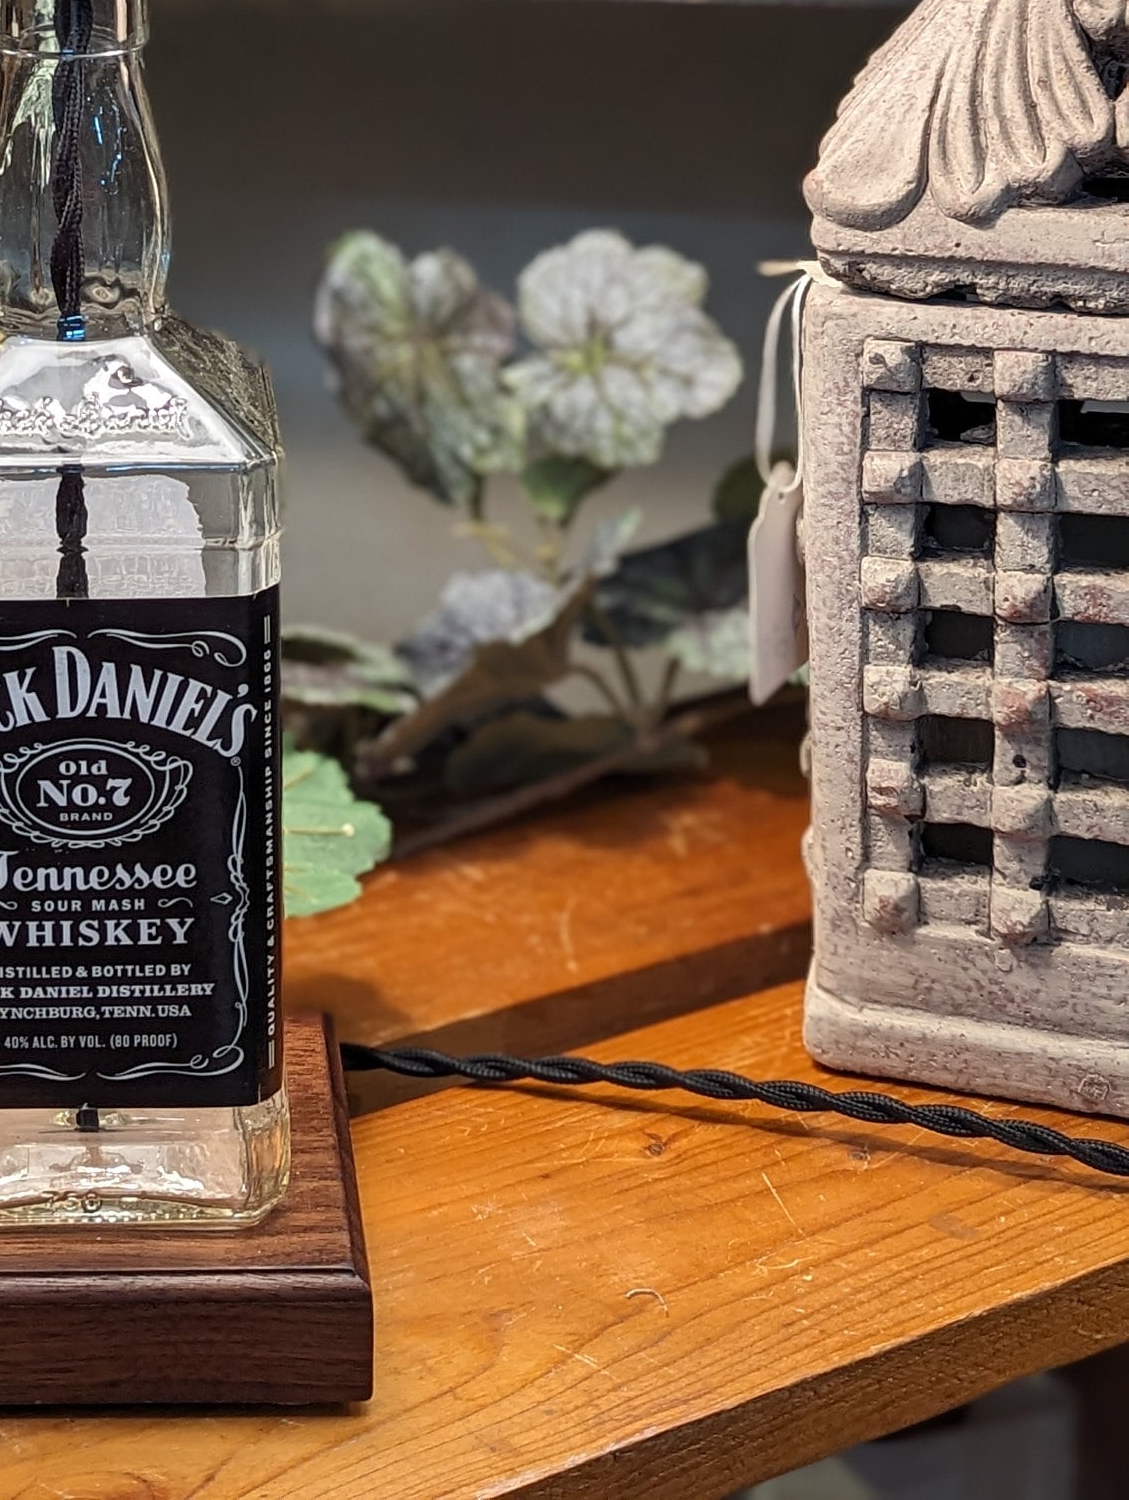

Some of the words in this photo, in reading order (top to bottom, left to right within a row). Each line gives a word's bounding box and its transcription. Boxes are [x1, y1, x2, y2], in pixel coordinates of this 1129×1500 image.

[263, 649, 271, 693] 1866
[52, 646, 258, 758] DANIEL'S
[264, 699, 272, 759] SINCE
[58, 760, 108, 776] Old
[36, 777, 133, 808] No.7
[59, 812, 113, 822] BRAND
[265, 766, 275, 930] CRAFTSMANSHIP
[31, 899, 82, 912] SOUR
[91, 898, 146, 911] MASH
[75, 966, 88, 978] &
[91, 965, 166, 978] BOTTLED
[170, 963, 191, 976] BY
[19, 986, 93, 999] DANIEL
[96, 983, 215, 998] DISTILLERY
[267, 955, 276, 1036] QUALITY
[101, 1005, 155, 1019] TENN.
[156, 1004, 192, 1018] USA
[4, 1036, 29, 1049] 40%
[32, 1035, 58, 1049] ALC.
[60, 1035, 76, 1048] BY
[79, 1035, 106, 1048] VOL.
[109, 1034, 130, 1049] (80
[133, 1033, 178, 1048] PROOF)
